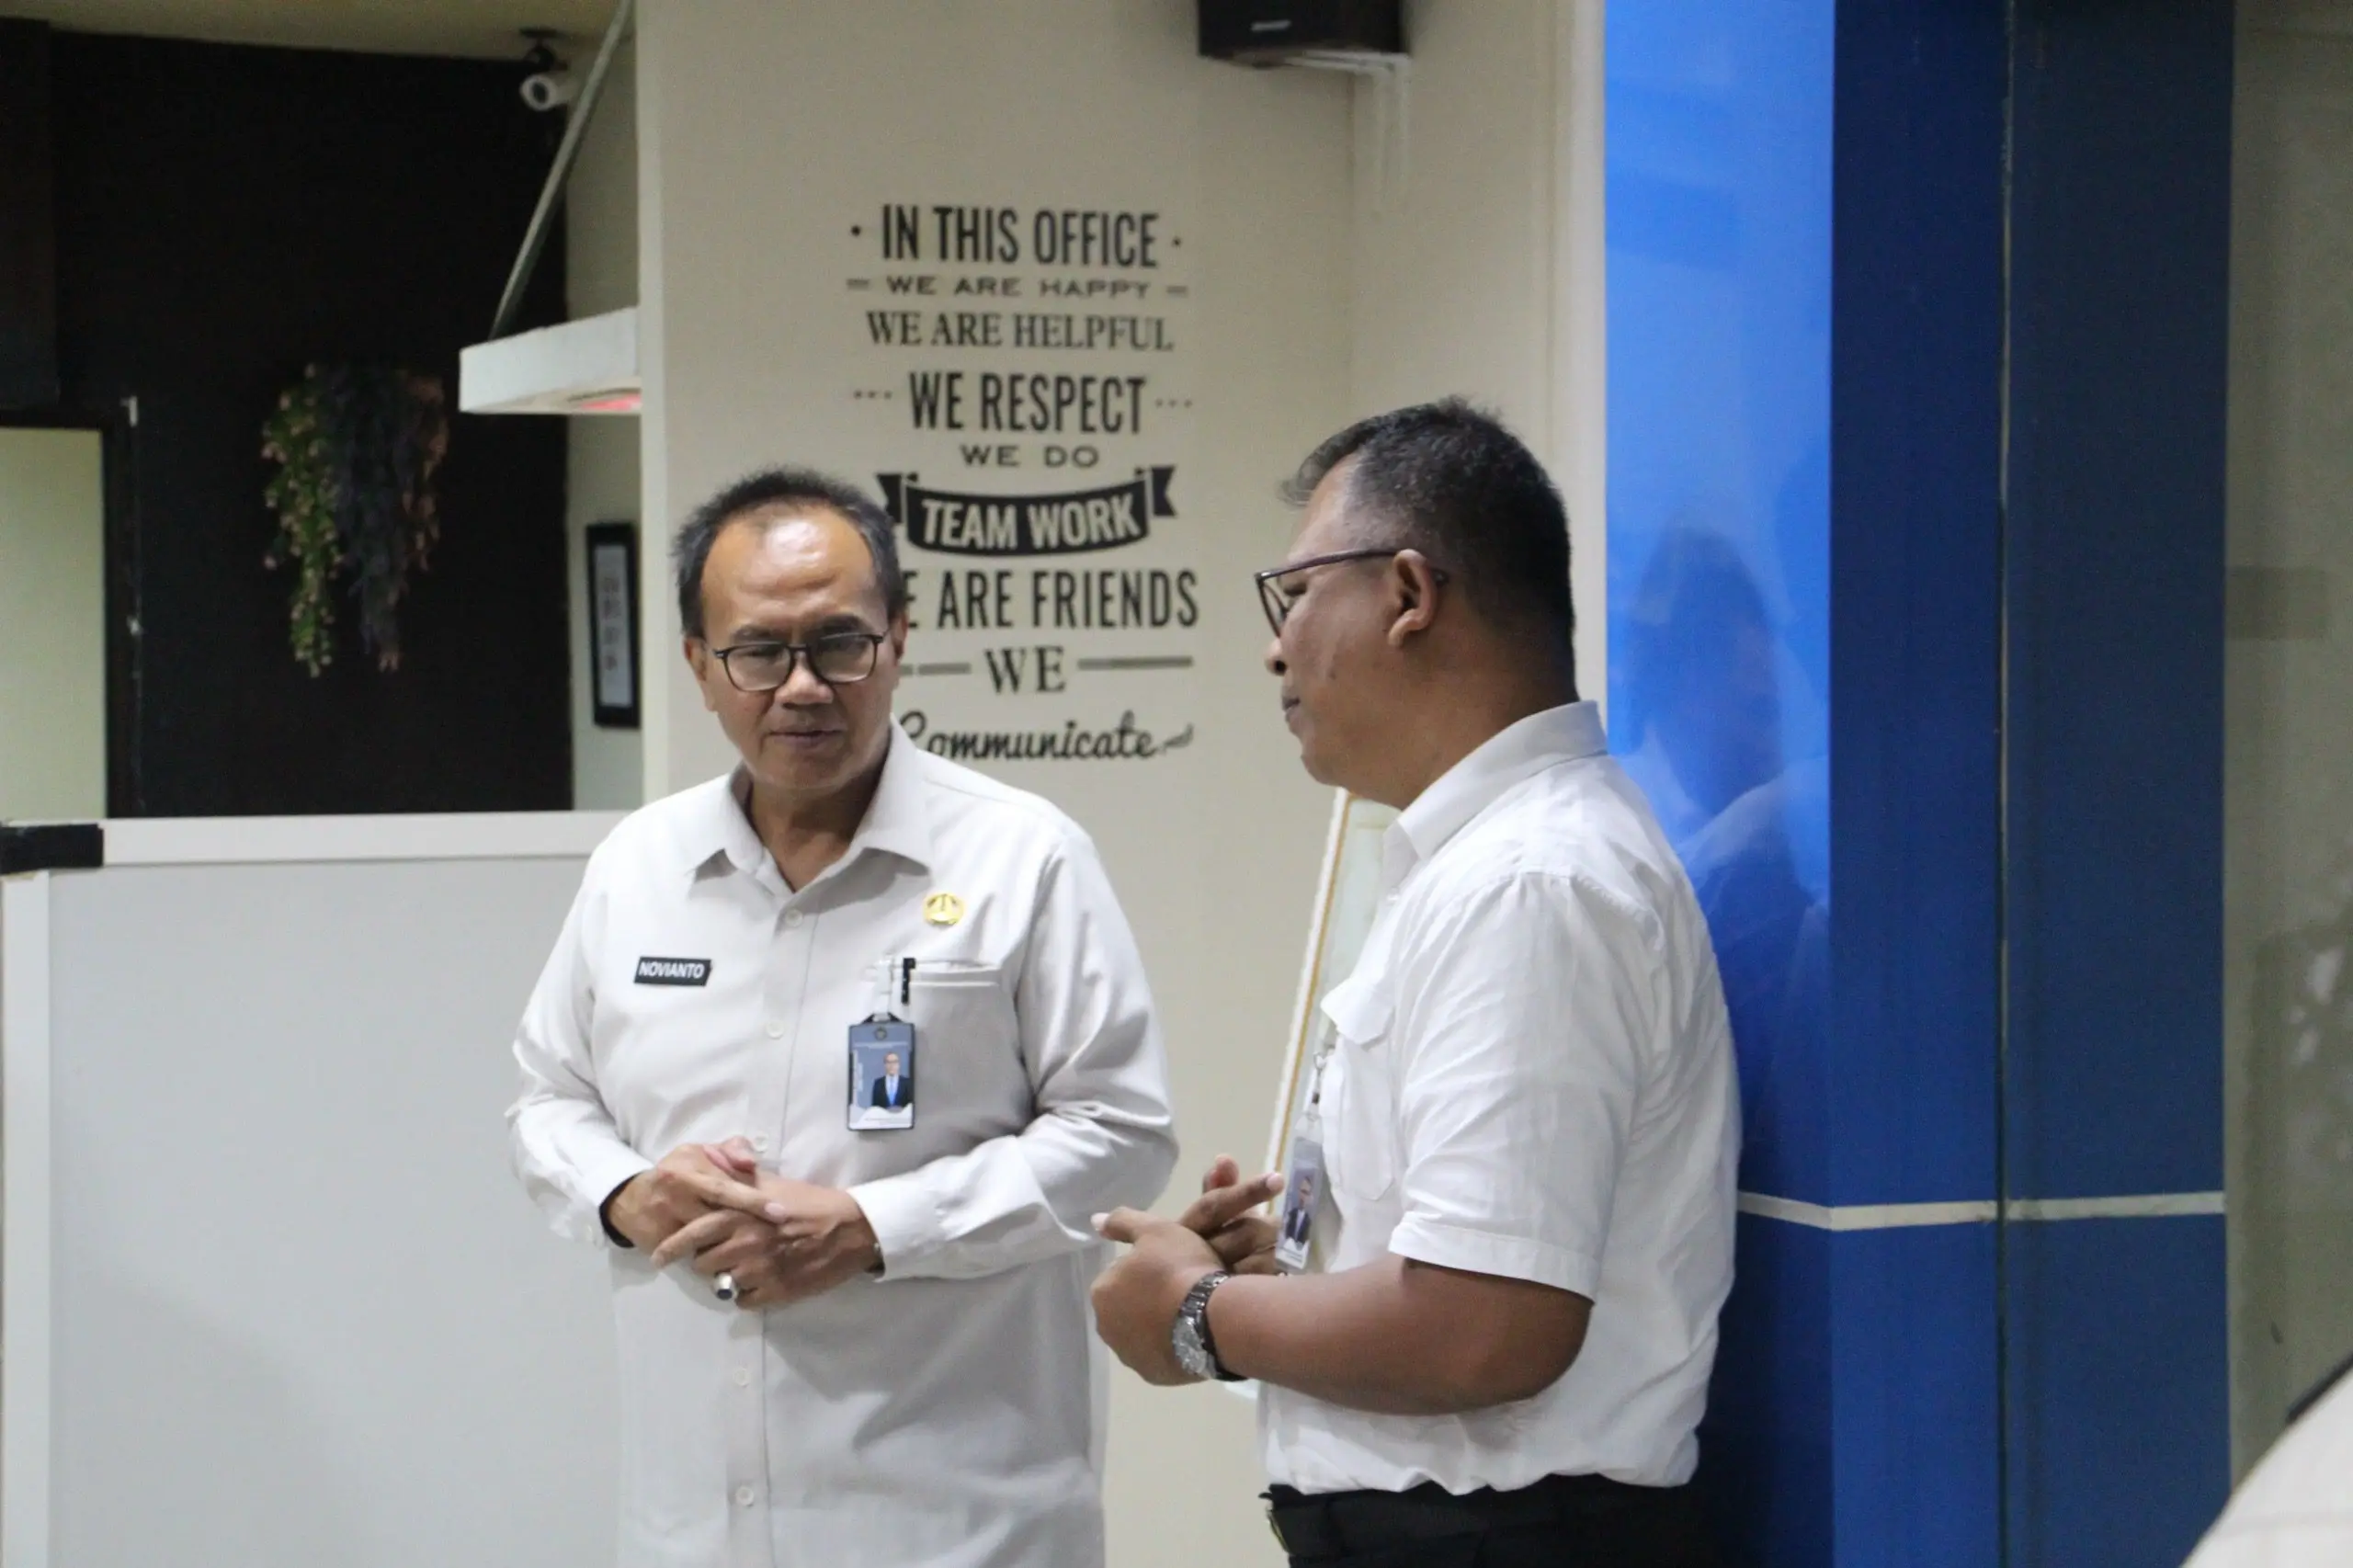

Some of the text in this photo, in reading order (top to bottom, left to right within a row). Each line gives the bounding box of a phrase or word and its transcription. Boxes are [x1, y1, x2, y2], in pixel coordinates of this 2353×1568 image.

[882, 204, 1159, 267] IN THIS OFFICE
[887, 277, 1151, 299] WE ARE HAPPY
[867, 311, 1175, 351] WE ARE HELPFUL
[910, 371, 1147, 434] WE RESPECT
[961, 445, 1099, 468] WE DO
[923, 494, 1141, 550] TEAM WORK
[937, 570, 1013, 629] ARE
[1032, 570, 1199, 629] FRIENDS
[985, 646, 1066, 694] WE
[638, 960, 705, 979] NOVIANTO
